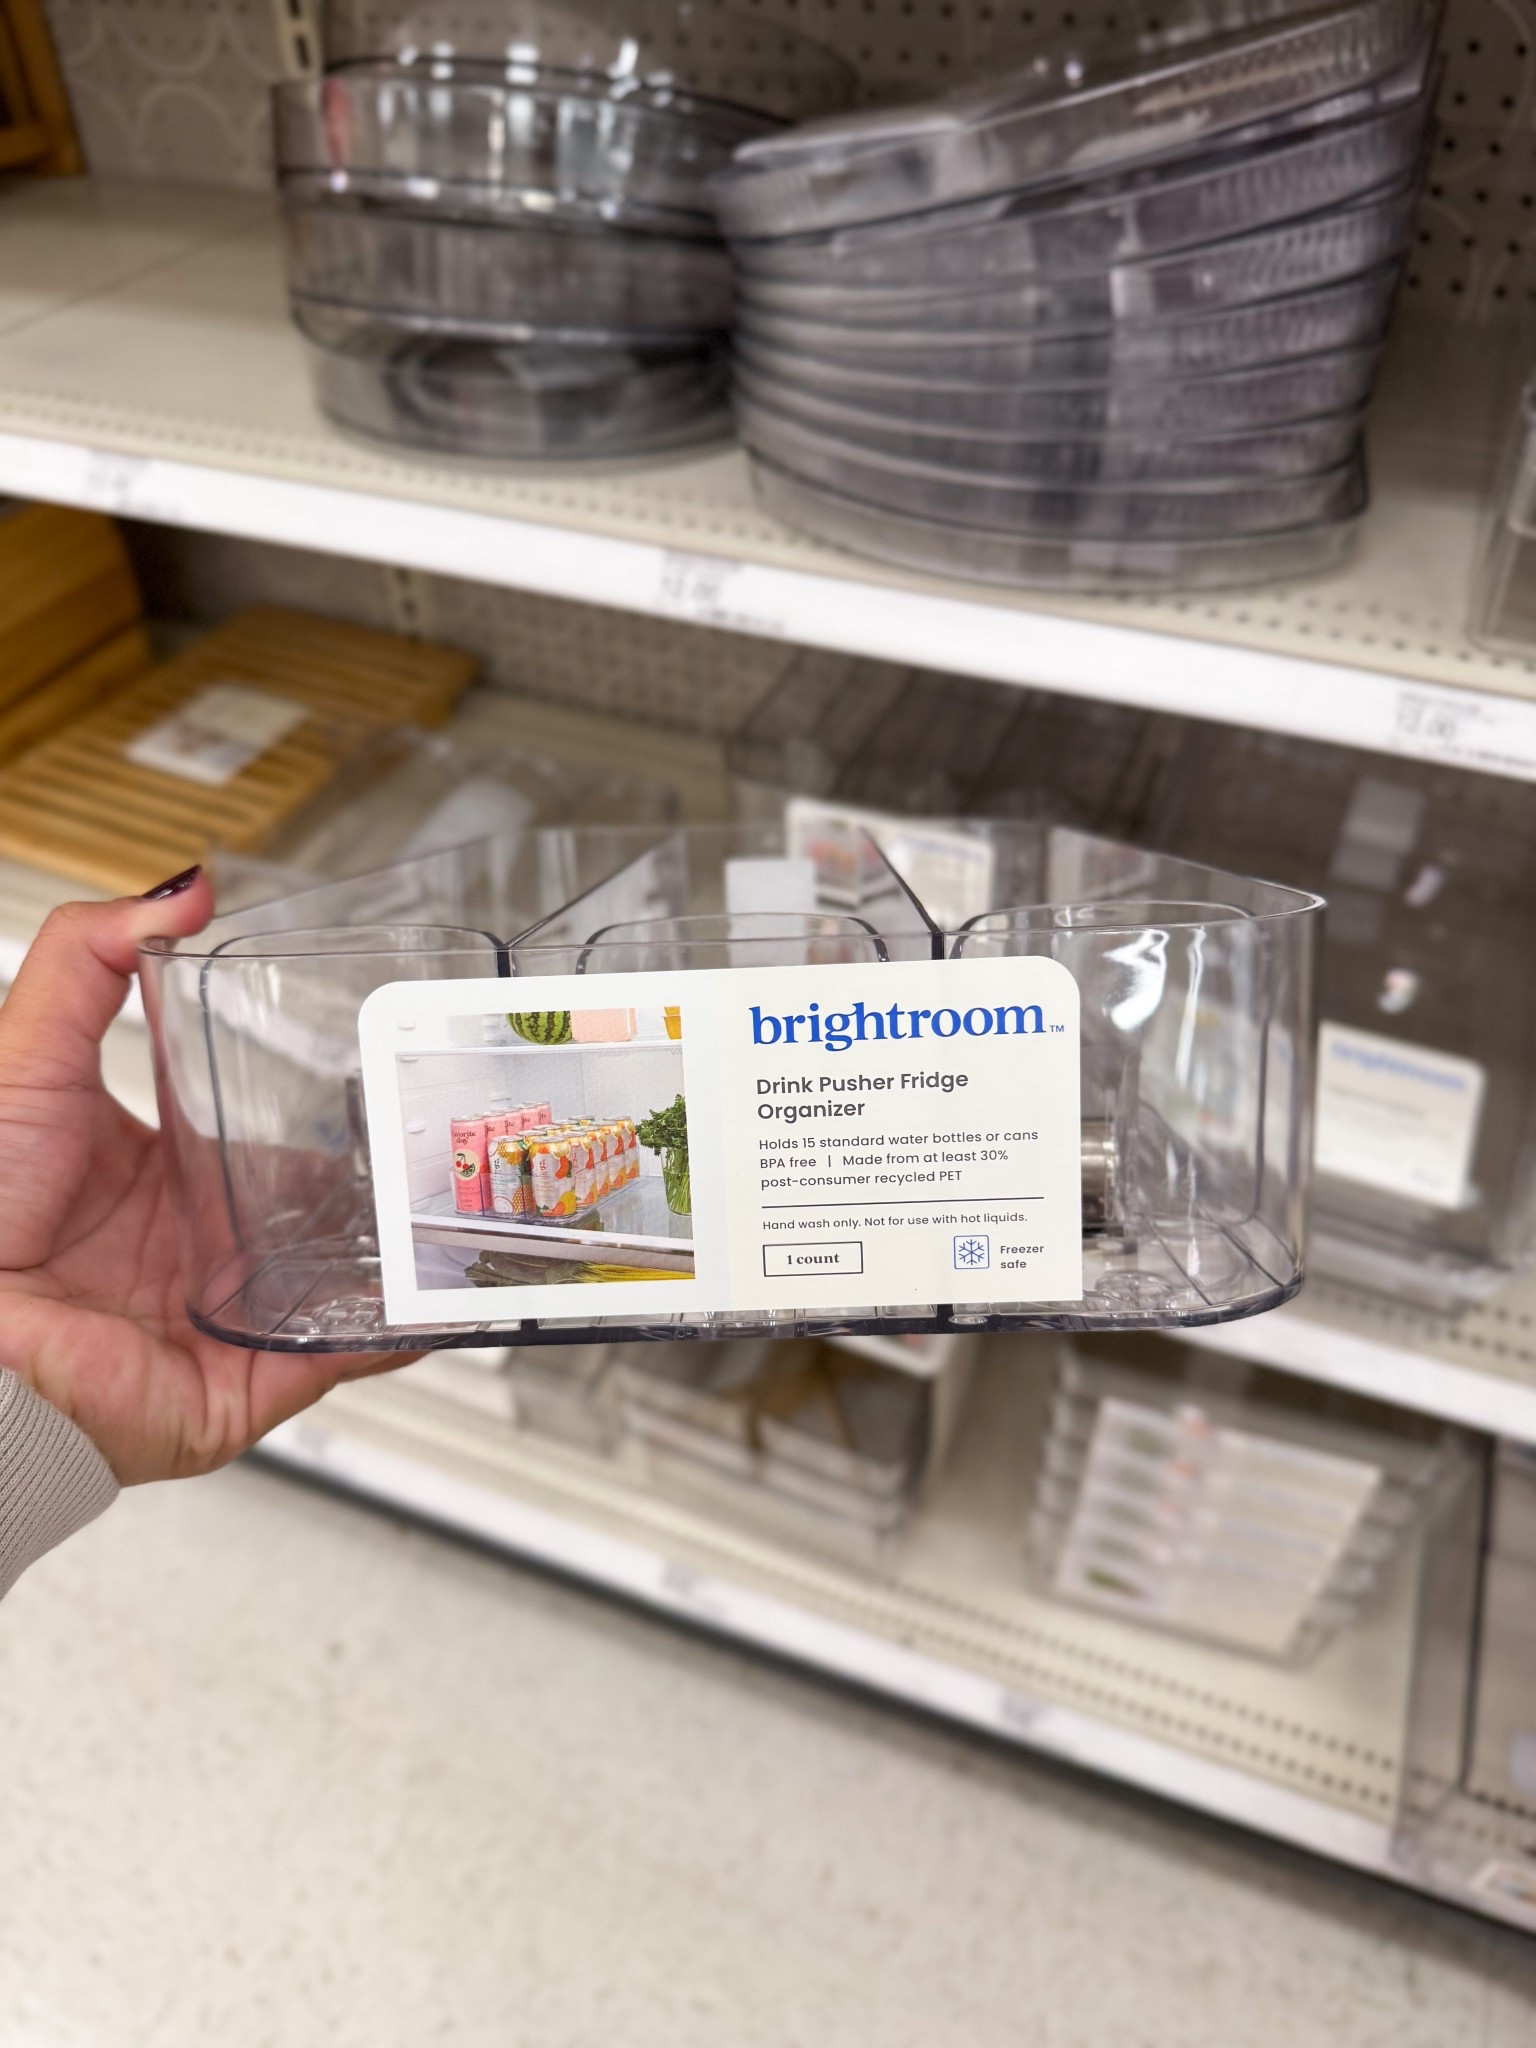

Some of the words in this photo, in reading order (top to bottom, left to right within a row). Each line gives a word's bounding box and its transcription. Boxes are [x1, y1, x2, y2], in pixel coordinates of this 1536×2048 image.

[756, 1076, 814, 1095] Drink
[819, 1074, 895, 1093] Pusher
[900, 1071, 969, 1093] Fridge
[757, 1099, 866, 1124] Organizer
[759, 1138, 799, 1150] Holds
[802, 1137, 816, 1148] 15
[819, 1135, 885, 1148] standard
[888, 1134, 929, 1145] water
[932, 1131, 982, 1144] bottles
[985, 1132, 1000, 1143] or
[1003, 1131, 1039, 1141] cans
[760, 1158, 786, 1169] BPA
[789, 1155, 817, 1168] free
[842, 1153, 883, 1167] Made
[886, 1153, 920, 1165] from
[923, 1153, 938, 1164] at
[941, 1151, 977, 1163] least
[980, 1149, 1009, 1161] 30%
[761, 1174, 871, 1191] post-consumer
[874, 1170, 935, 1186] recycled
[939, 1170, 963, 1182] PET
[762, 1220, 795, 1231] Hand
[798, 1218, 830, 1229] wash
[833, 1217, 862, 1230] only.
[864, 1216, 885, 1227] Not
[888, 1215, 904, 1227] for
[907, 1215, 929, 1226] use
[931, 1213, 958, 1225] with
[960, 1212, 981, 1224] hot
[983, 1210, 1028, 1226] liquids.
[787, 1253, 794, 1266] 1
[796, 1252, 840, 1265] count
[1000, 1245, 1045, 1254] Freezer
[1000, 1259, 1027, 1269] safe
